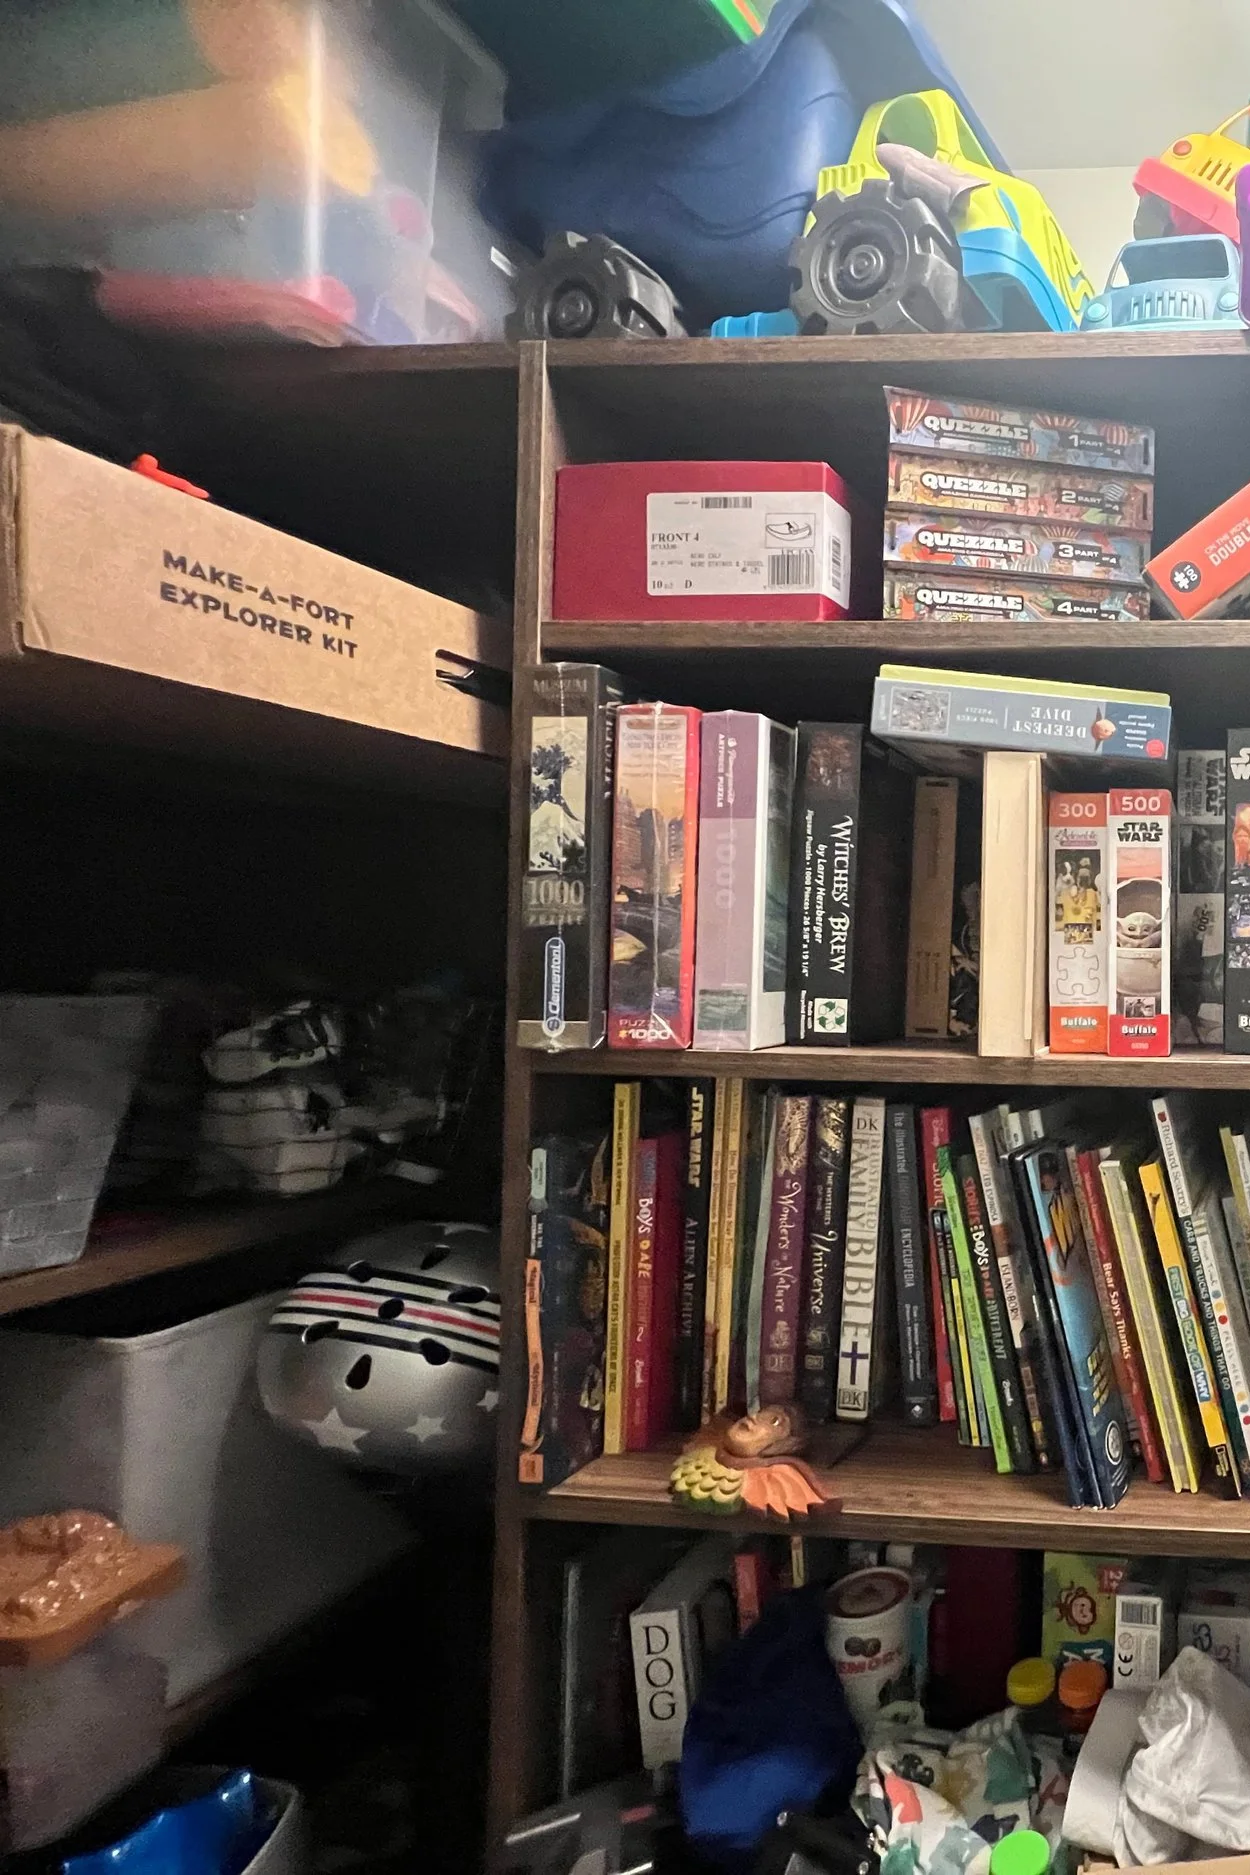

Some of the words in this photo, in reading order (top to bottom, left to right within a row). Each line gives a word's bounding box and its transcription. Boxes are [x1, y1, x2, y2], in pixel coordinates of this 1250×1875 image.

[924, 416, 1030, 440] QUEZZLE
[1068, 435, 1079, 447] 1
[1079, 439, 1103, 447] PART
[922, 473, 1027, 497] QUEZZLE
[1062, 490, 1076, 503] 2
[1078, 496, 1101, 504] PART
[652, 533, 689, 543] FRONT
[693, 533, 700, 542] 4
[918, 532, 1023, 554] QUEZZLE
[1058, 545, 1073, 558] 3
[1075, 550, 1099, 558] PART
[652, 580, 663, 589] 10
[685, 580, 692, 588] D
[1185, 564, 1198, 582] 100
[162, 548, 355, 631] MAKE-A-FORT
[916, 590, 1022, 610] QUEZZLE
[160, 581, 313, 645] EXPLORER
[322, 633, 358, 659] KIT
[1057, 602, 1072, 614] 4
[1073, 606, 1098, 614] PART
[1030, 705, 1072, 721] DIVE
[1012, 721, 1087, 740] DEEPEST
[1059, 803, 1097, 818] 300
[1121, 796, 1160, 812] 500
[1117, 822, 1163, 832] STAR
[1118, 832, 1163, 842] WARS
[816, 843, 828, 857] by
[815, 858, 827, 886] Larry
[527, 880, 584, 905] 1000
[813, 887, 826, 944] Hersberger
[828, 911, 850, 974] BREW
[1061, 1017, 1098, 1026] Buffalo
[1121, 1025, 1157, 1034] Buffalo
[690, 1086, 704, 1137] STAR
[856, 1117, 880, 1132] DK
[1162, 1123, 1179, 1171] Richard
[688, 1137, 702, 1189] WARS
[848, 1140, 869, 1227] FAMILY
[866, 1139, 881, 1230] ILLUSTRATED
[1169, 1172, 1190, 1217] Scarry's
[779, 1181, 801, 1250] Wonders
[823, 1189, 834, 1226] MYSTERIES
[684, 1217, 700, 1266] ALIEN
[1190, 1244, 1202, 1263] AND
[901, 1228, 915, 1289] ENCYCLOPEDIA
[809, 1230, 839, 1315] Universe
[1194, 1264, 1210, 1300] TRUCKS
[771, 1261, 798, 1313] Nature
[842, 1234, 877, 1338] BIBLE
[1001, 1263, 1020, 1321] ISLANDBORN
[681, 1269, 697, 1338] ARCHIVE
[1101, 1261, 1115, 1288] Bear
[1108, 1291, 1121, 1317] Says
[1115, 1319, 1132, 1360] Thanks
[1179, 1301, 1191, 1319] BIG
[1201, 1301, 1214, 1319] AND
[1183, 1321, 1198, 1353] BOOK
[1206, 1320, 1222, 1352] THINGS
[1190, 1355, 1202, 1370] OF
[1214, 1353, 1228, 1374] THAT
[1195, 1371, 1211, 1400] WHY
[1222, 1376, 1232, 1391] GO
[841, 1392, 865, 1409] DK
[643, 1625, 677, 1722] DOG
